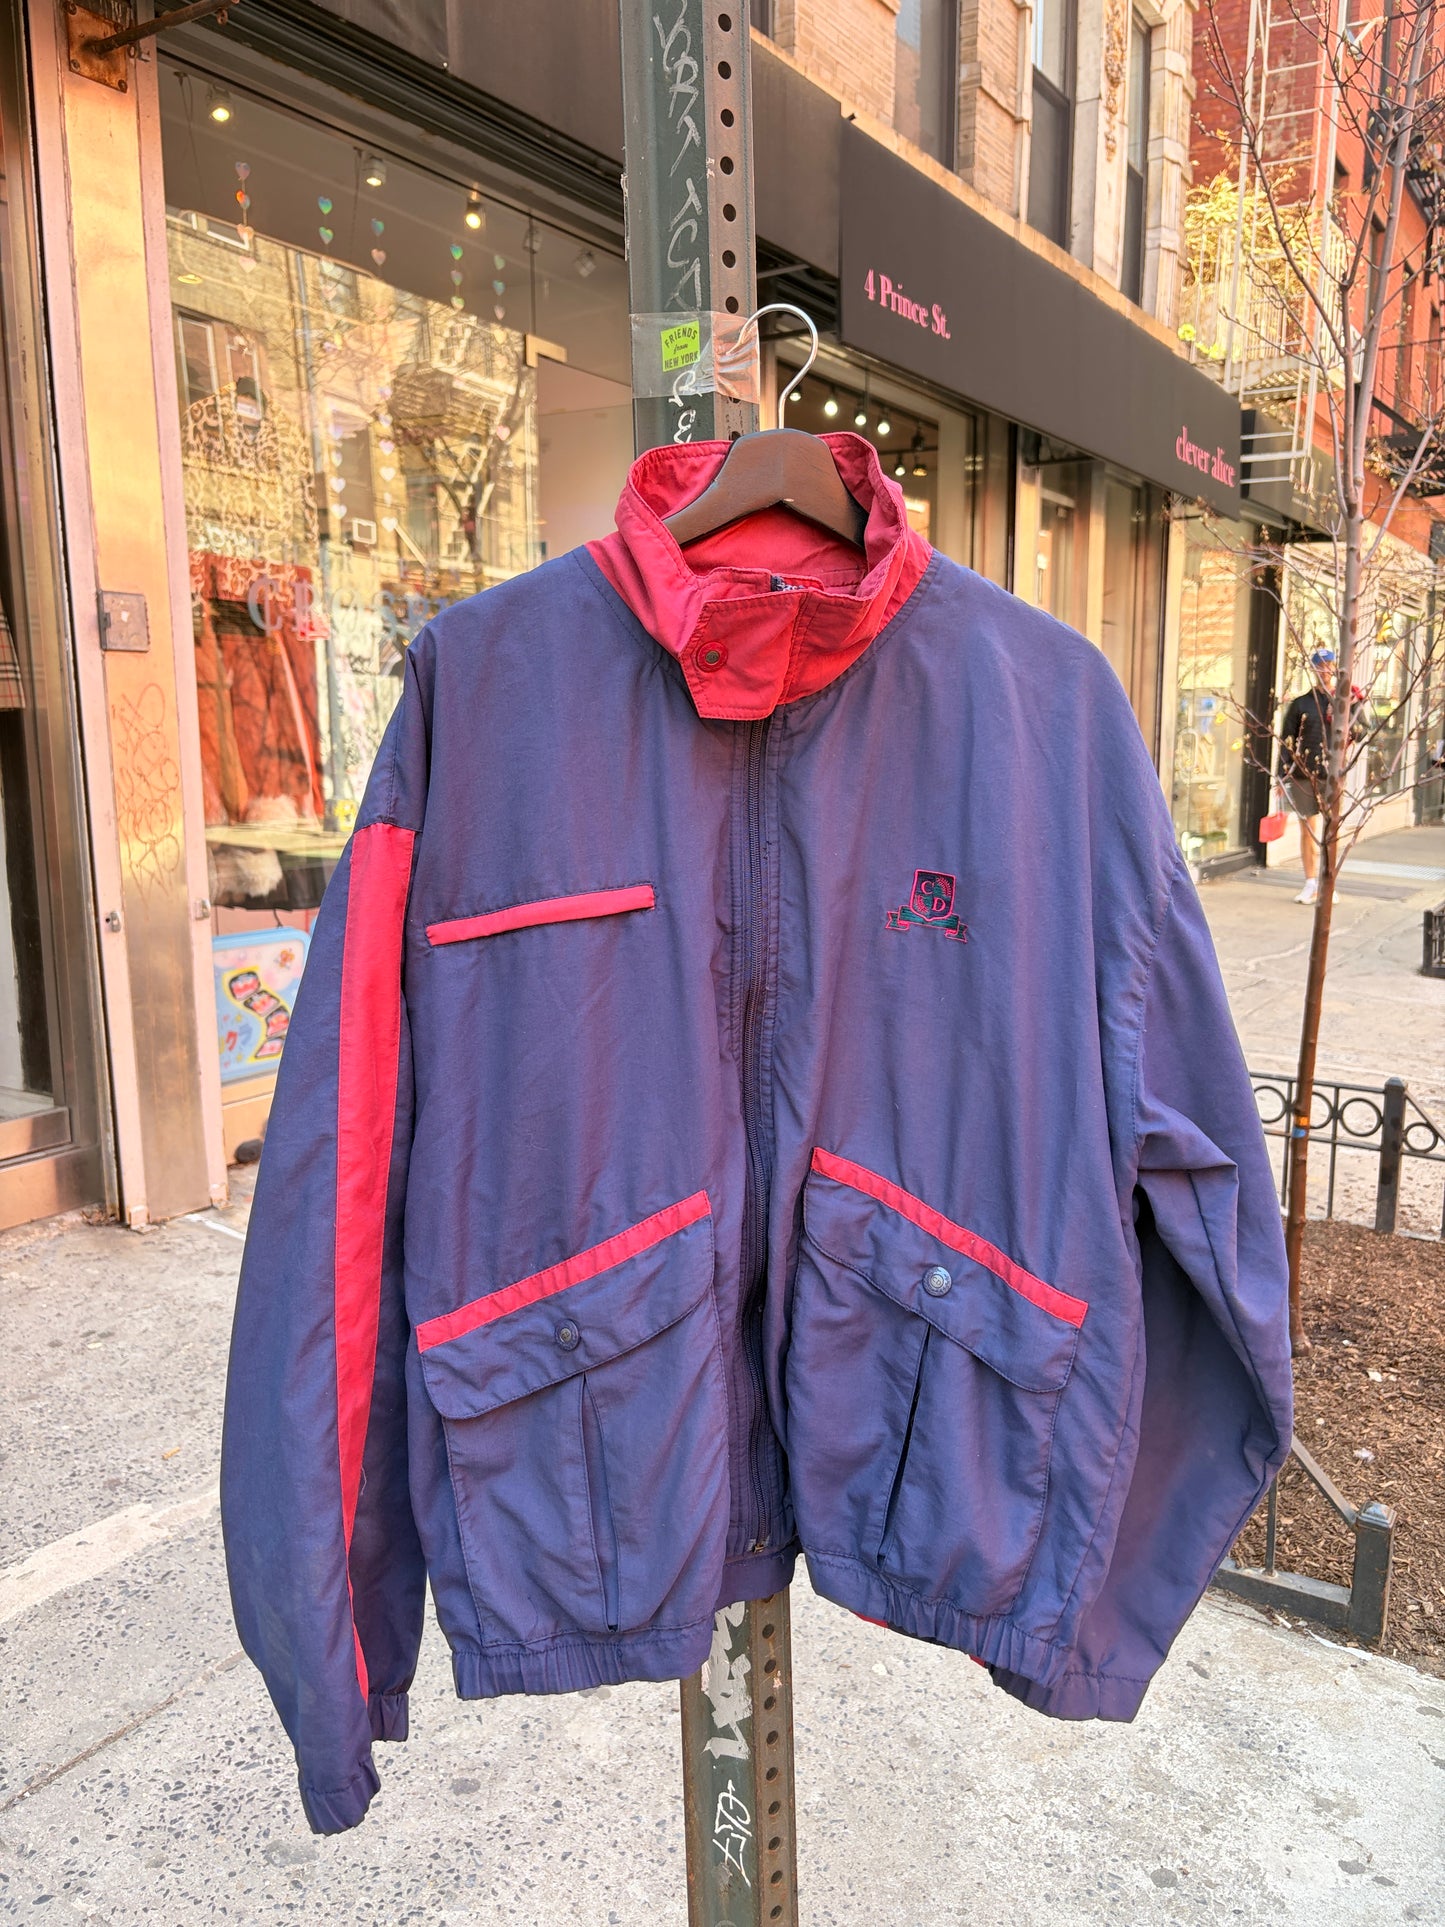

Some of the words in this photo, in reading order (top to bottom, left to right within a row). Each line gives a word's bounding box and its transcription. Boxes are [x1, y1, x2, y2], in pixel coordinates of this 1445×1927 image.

[864, 268, 875, 301] 4
[879, 273, 929, 328] Prince
[931, 303, 951, 339] St.
[664, 327, 698, 348] FRIENDS
[673, 344, 688, 354] from
[664, 356, 679, 369] NEW
[681, 351, 699, 364] YORK
[1175, 425, 1210, 474] clever
[1211, 446, 1236, 488] alice
